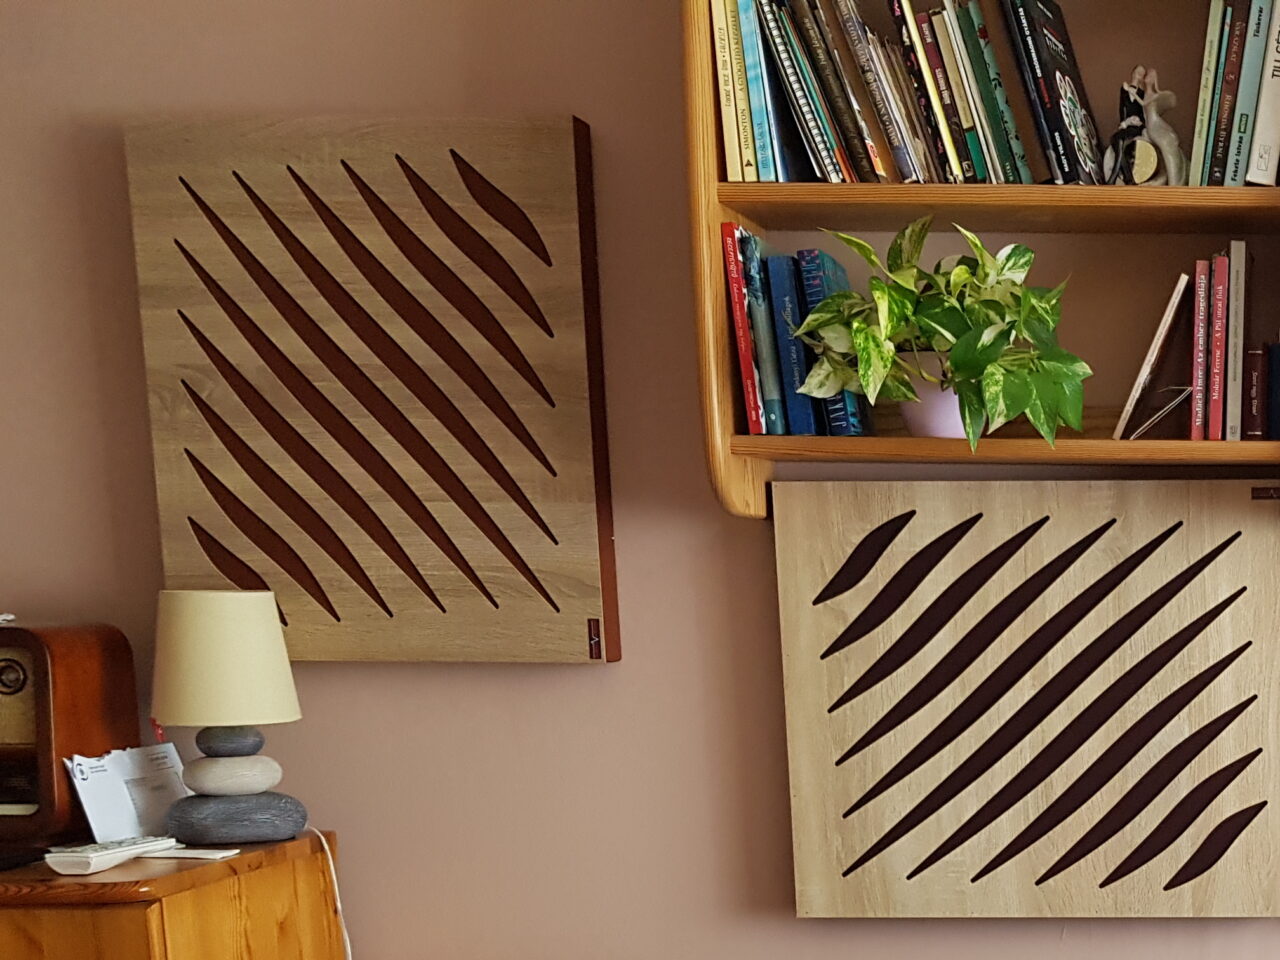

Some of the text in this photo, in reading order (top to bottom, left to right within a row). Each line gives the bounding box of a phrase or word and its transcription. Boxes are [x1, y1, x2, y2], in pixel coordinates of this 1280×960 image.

[740, 108, 749, 150] SIMONTON
[1054, 131, 1063, 154] VILMOS
[1234, 135, 1243, 156] István
[1230, 158, 1239, 181] Fekete
[1197, 352, 1203, 363] Az
